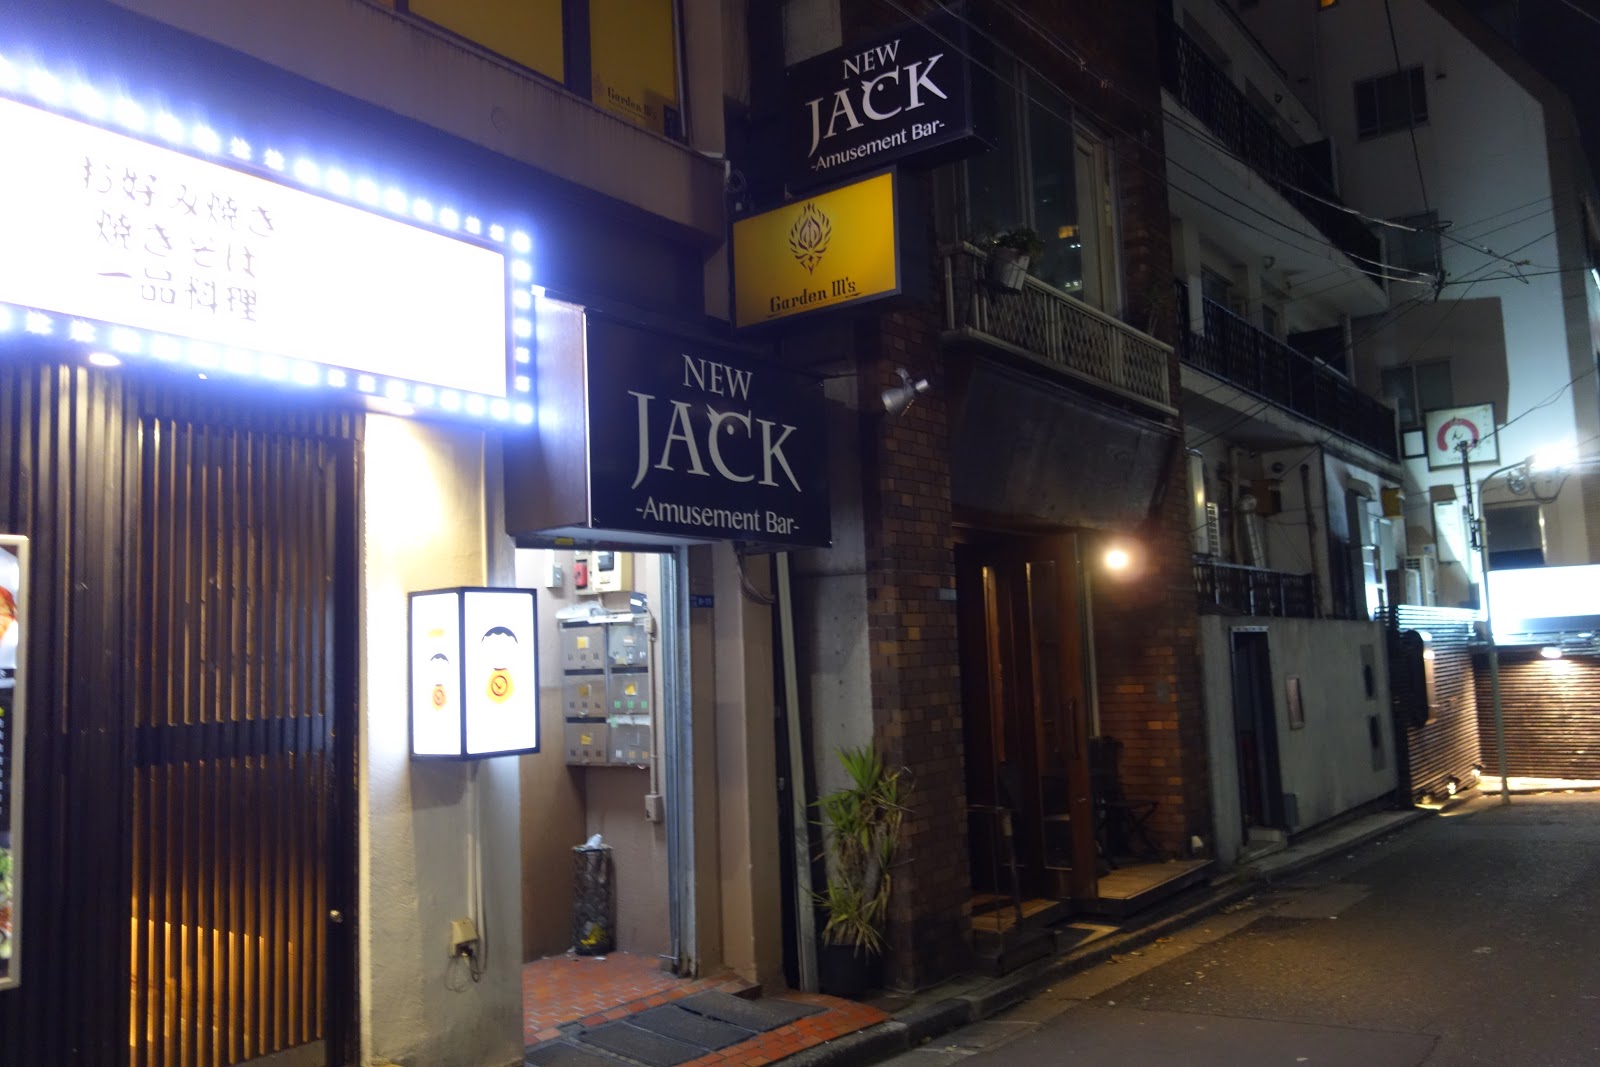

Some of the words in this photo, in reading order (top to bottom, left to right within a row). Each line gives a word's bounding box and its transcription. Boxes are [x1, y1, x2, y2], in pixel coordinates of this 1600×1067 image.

[842, 39, 900, 80] NEW
[805, 53, 948, 158] JACK
[811, 128, 907, 172] -Amusement
[911, 119, 945, 141] Bar-
[96, 267, 257, 322] 一品料理
[769, 288, 827, 313] Garden
[682, 354, 752, 400] NEW
[627, 390, 802, 492] JACK
[635, 495, 761, 532] -Amusement
[765, 511, 800, 535] Bar-
